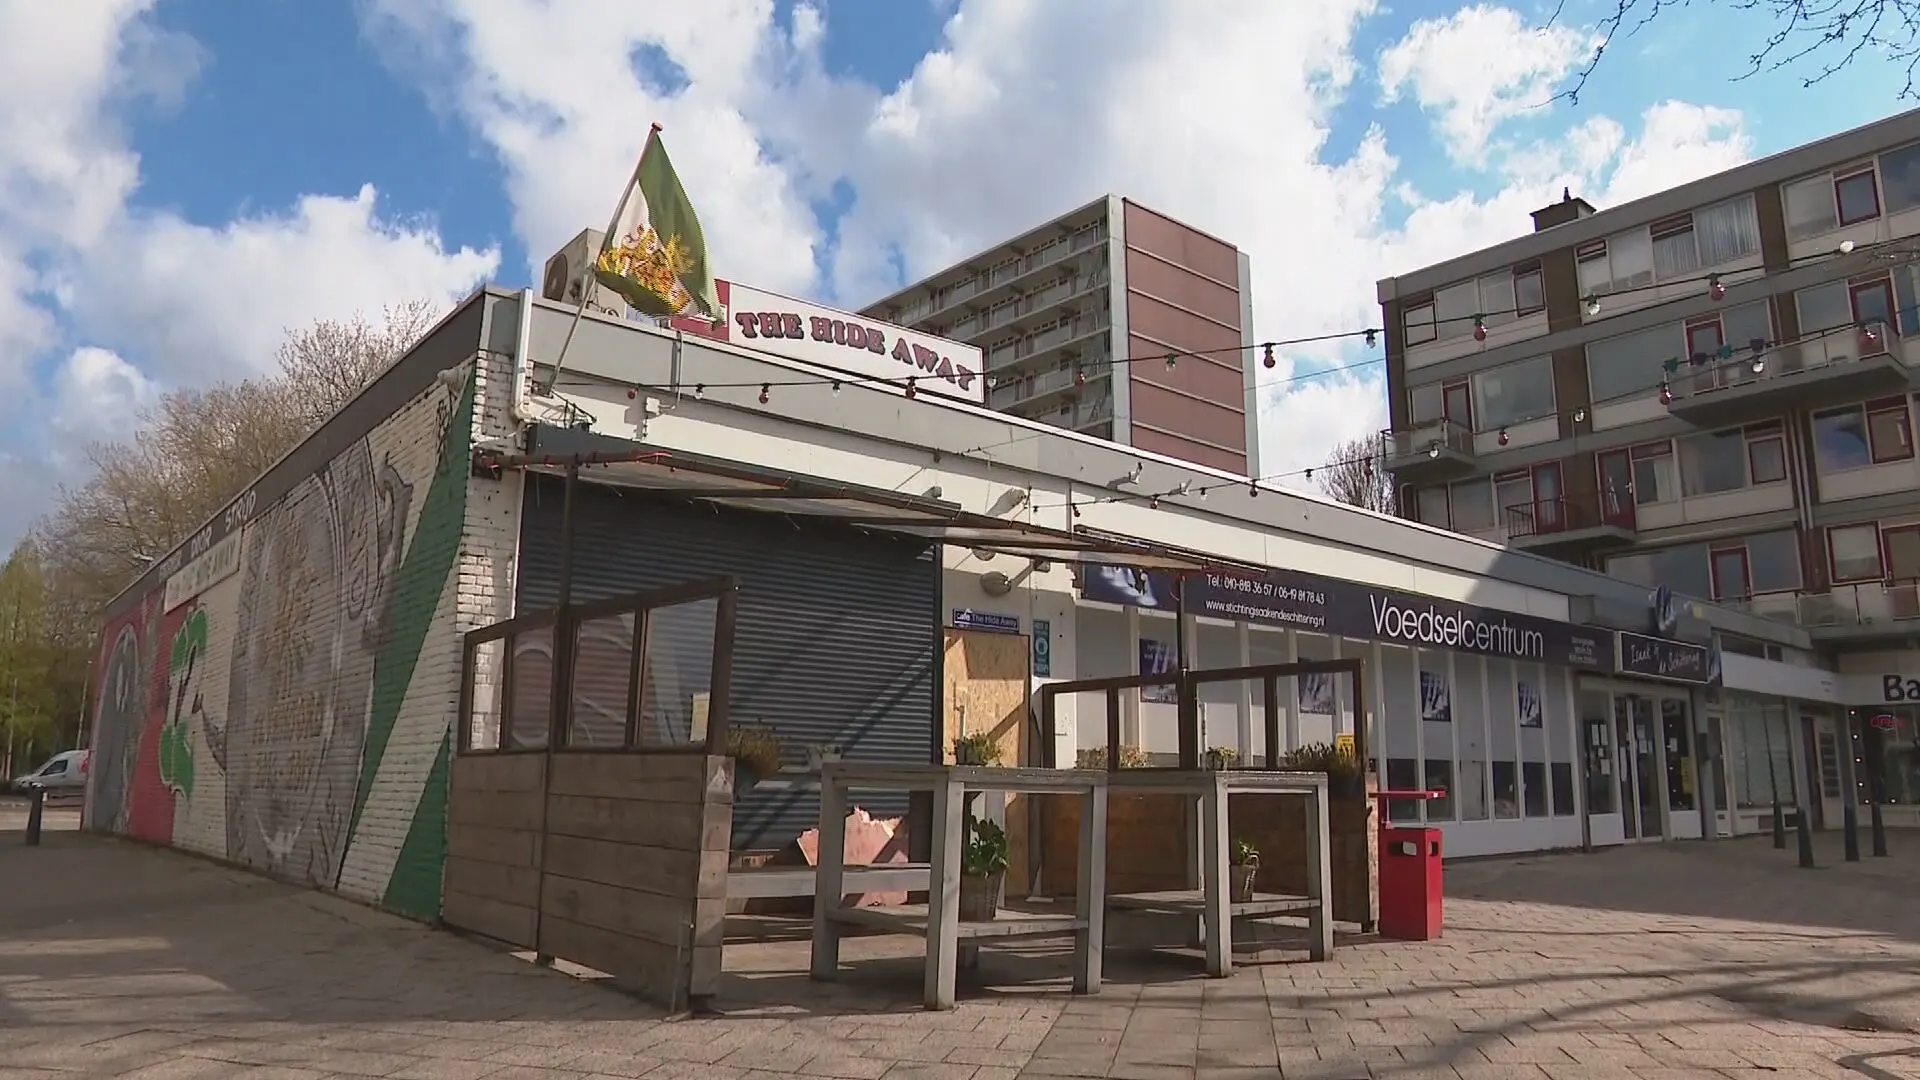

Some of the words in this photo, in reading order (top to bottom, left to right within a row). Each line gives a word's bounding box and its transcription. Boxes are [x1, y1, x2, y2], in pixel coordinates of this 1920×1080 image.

[735, 312, 804, 339] THE
[810, 316, 886, 355] HIDE
[891, 337, 976, 391] AWAY
[1369, 594, 1544, 658] Voedselcentrum
